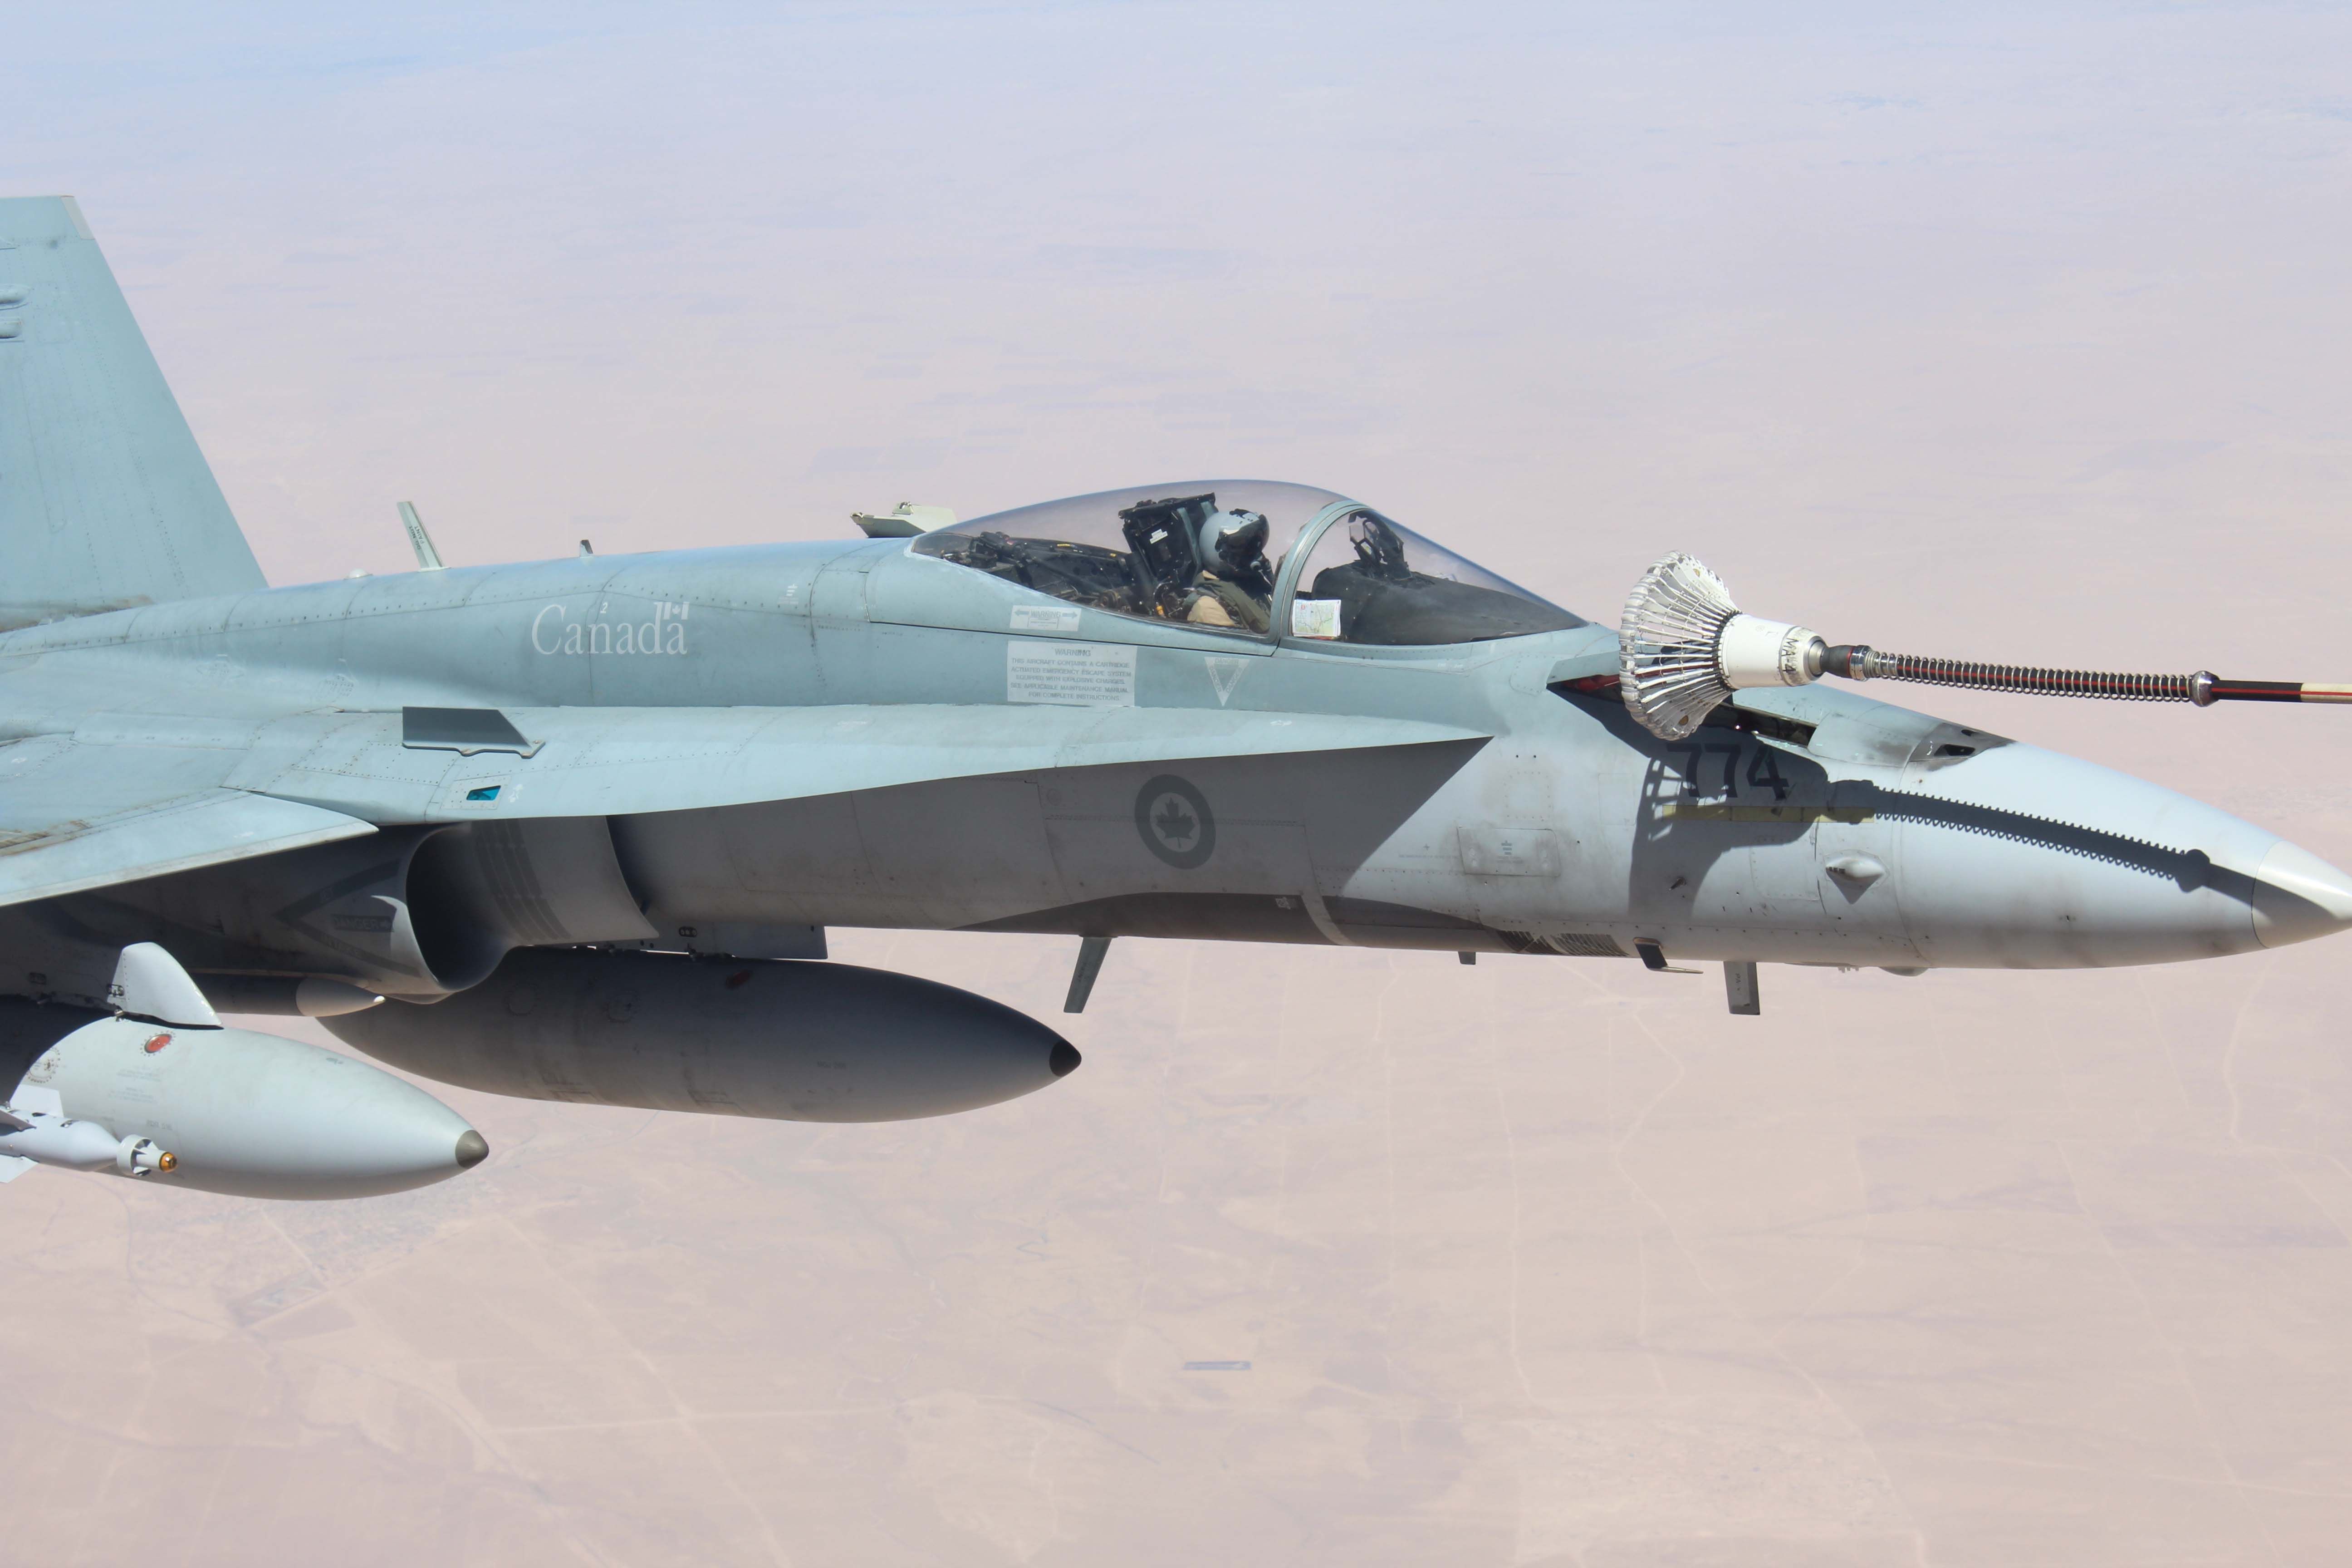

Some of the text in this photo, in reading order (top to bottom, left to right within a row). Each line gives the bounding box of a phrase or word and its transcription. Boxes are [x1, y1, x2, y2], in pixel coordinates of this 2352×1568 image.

[414, 525, 425, 544] PAINT
[600, 602, 608, 614] 2
[531, 602, 688, 655] Canada
[1055, 648, 1091, 657] WARNING
[1781, 637, 1799, 672] MA-4
[1666, 743, 1789, 800] 774
